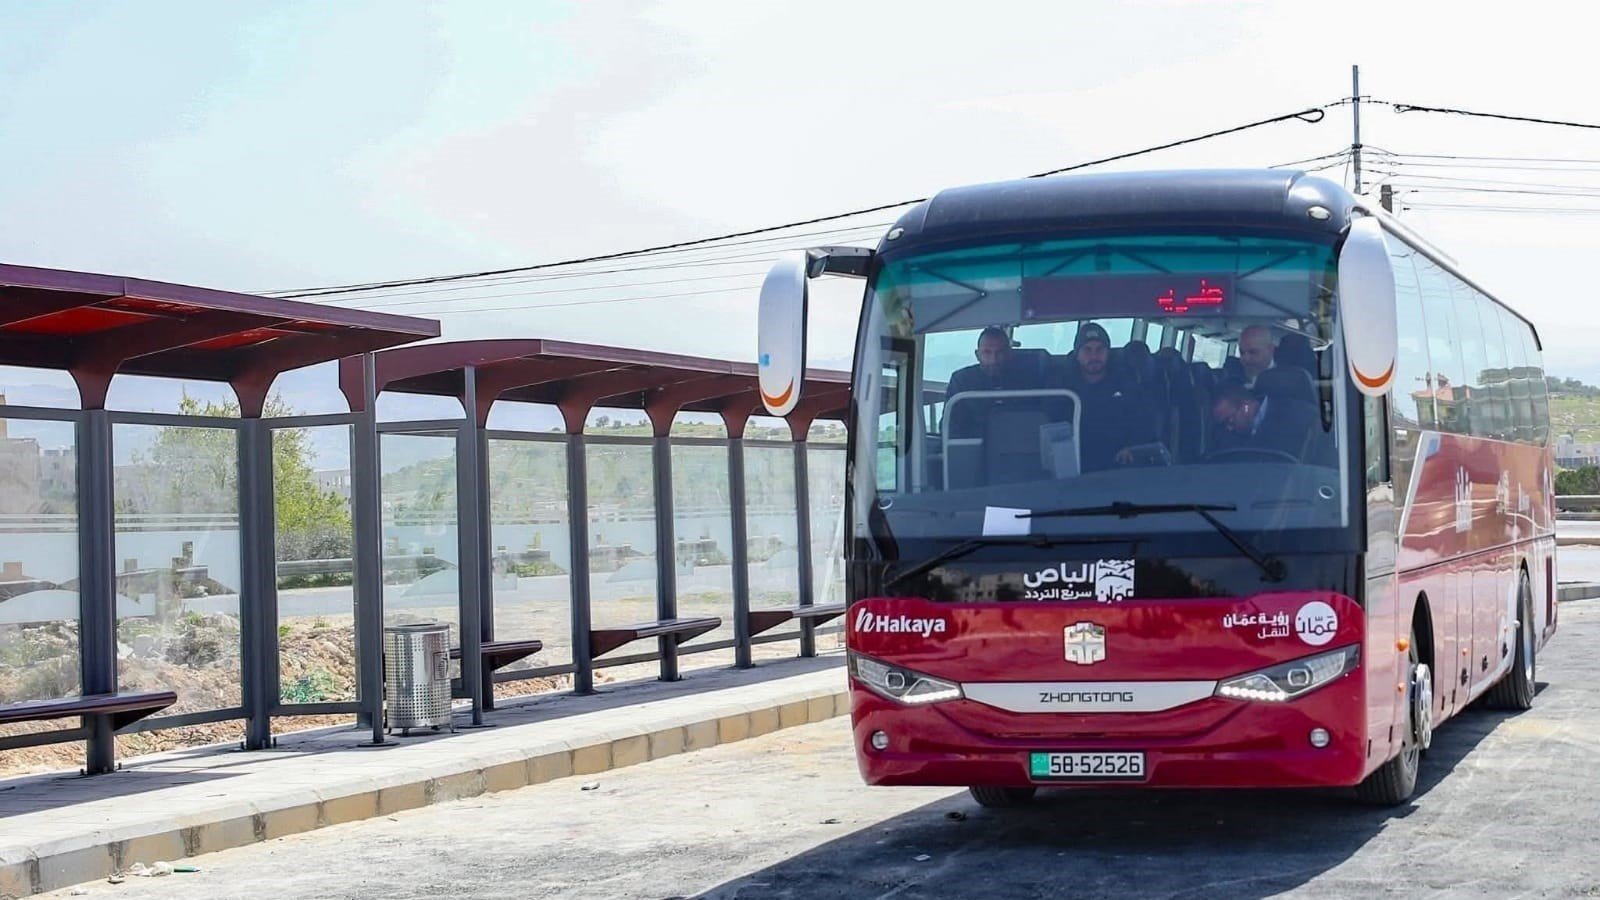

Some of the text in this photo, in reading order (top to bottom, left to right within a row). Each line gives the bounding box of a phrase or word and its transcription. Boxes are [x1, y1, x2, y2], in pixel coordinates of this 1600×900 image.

[1023, 562, 1095, 588] الباص
[1024, 588, 1092, 601] سريع التردد
[876, 615, 946, 638] Hakaya
[1258, 611, 1289, 627] رؤية
[1257, 625, 1290, 639] للنقل
[1039, 691, 1134, 703] ZHONGTONG
